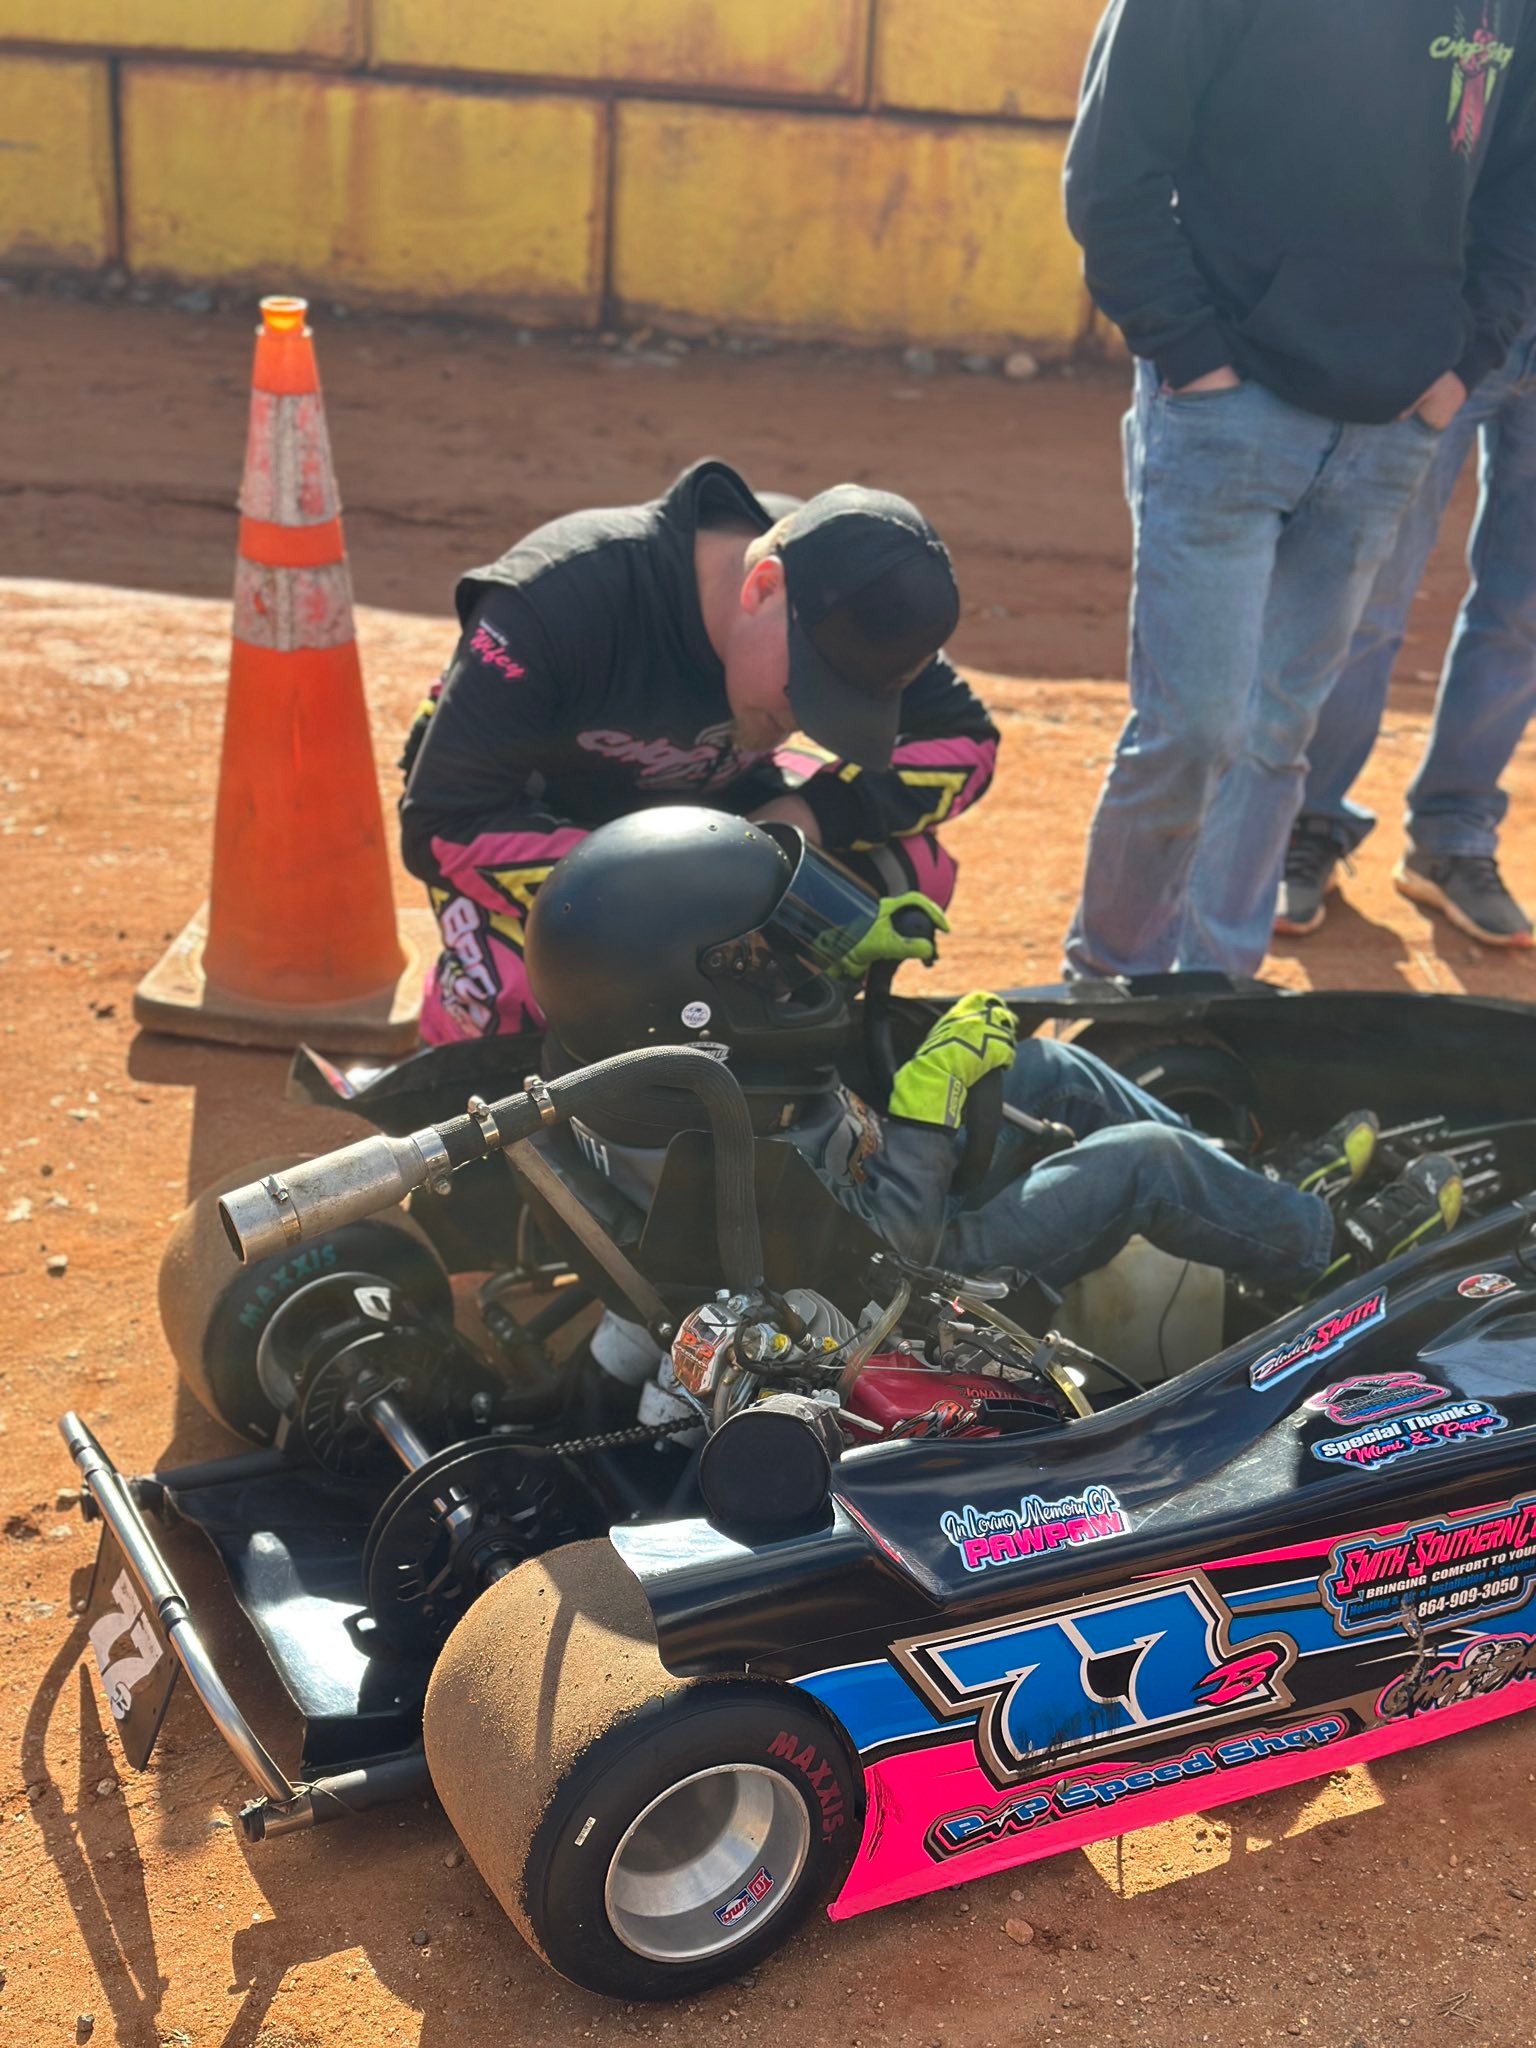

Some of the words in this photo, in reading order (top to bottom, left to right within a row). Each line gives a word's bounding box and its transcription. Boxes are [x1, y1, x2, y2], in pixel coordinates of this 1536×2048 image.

[239, 1243, 337, 1330] MAXXIS
[1310, 1295, 1380, 1351] SMITH
[1321, 1422, 1402, 1458] Special
[1403, 1402, 1483, 1431] Thanks
[1345, 1440, 1405, 1463] Mimi
[1408, 1432, 1433, 1444] &
[1432, 1416, 1494, 1437] Papa
[946, 1513, 967, 1540] In
[969, 1508, 1018, 1538] Loving
[1018, 1498, 1088, 1527] Memory
[1088, 1487, 1114, 1517] Of
[962, 1511, 1126, 1568] PAWPAW
[1336, 1543, 1410, 1596] SMITH
[1366, 1574, 1428, 1599] BRINGING
[1432, 1557, 1490, 1582] COMFORT
[1491, 1552, 1507, 1566] TO
[1417, 1575, 1519, 1618] 864-909-3050
[768, 1730, 844, 1834] MAXXIS
[1056, 1750, 1217, 1808] Speed
[1217, 1720, 1340, 1765] Shop
